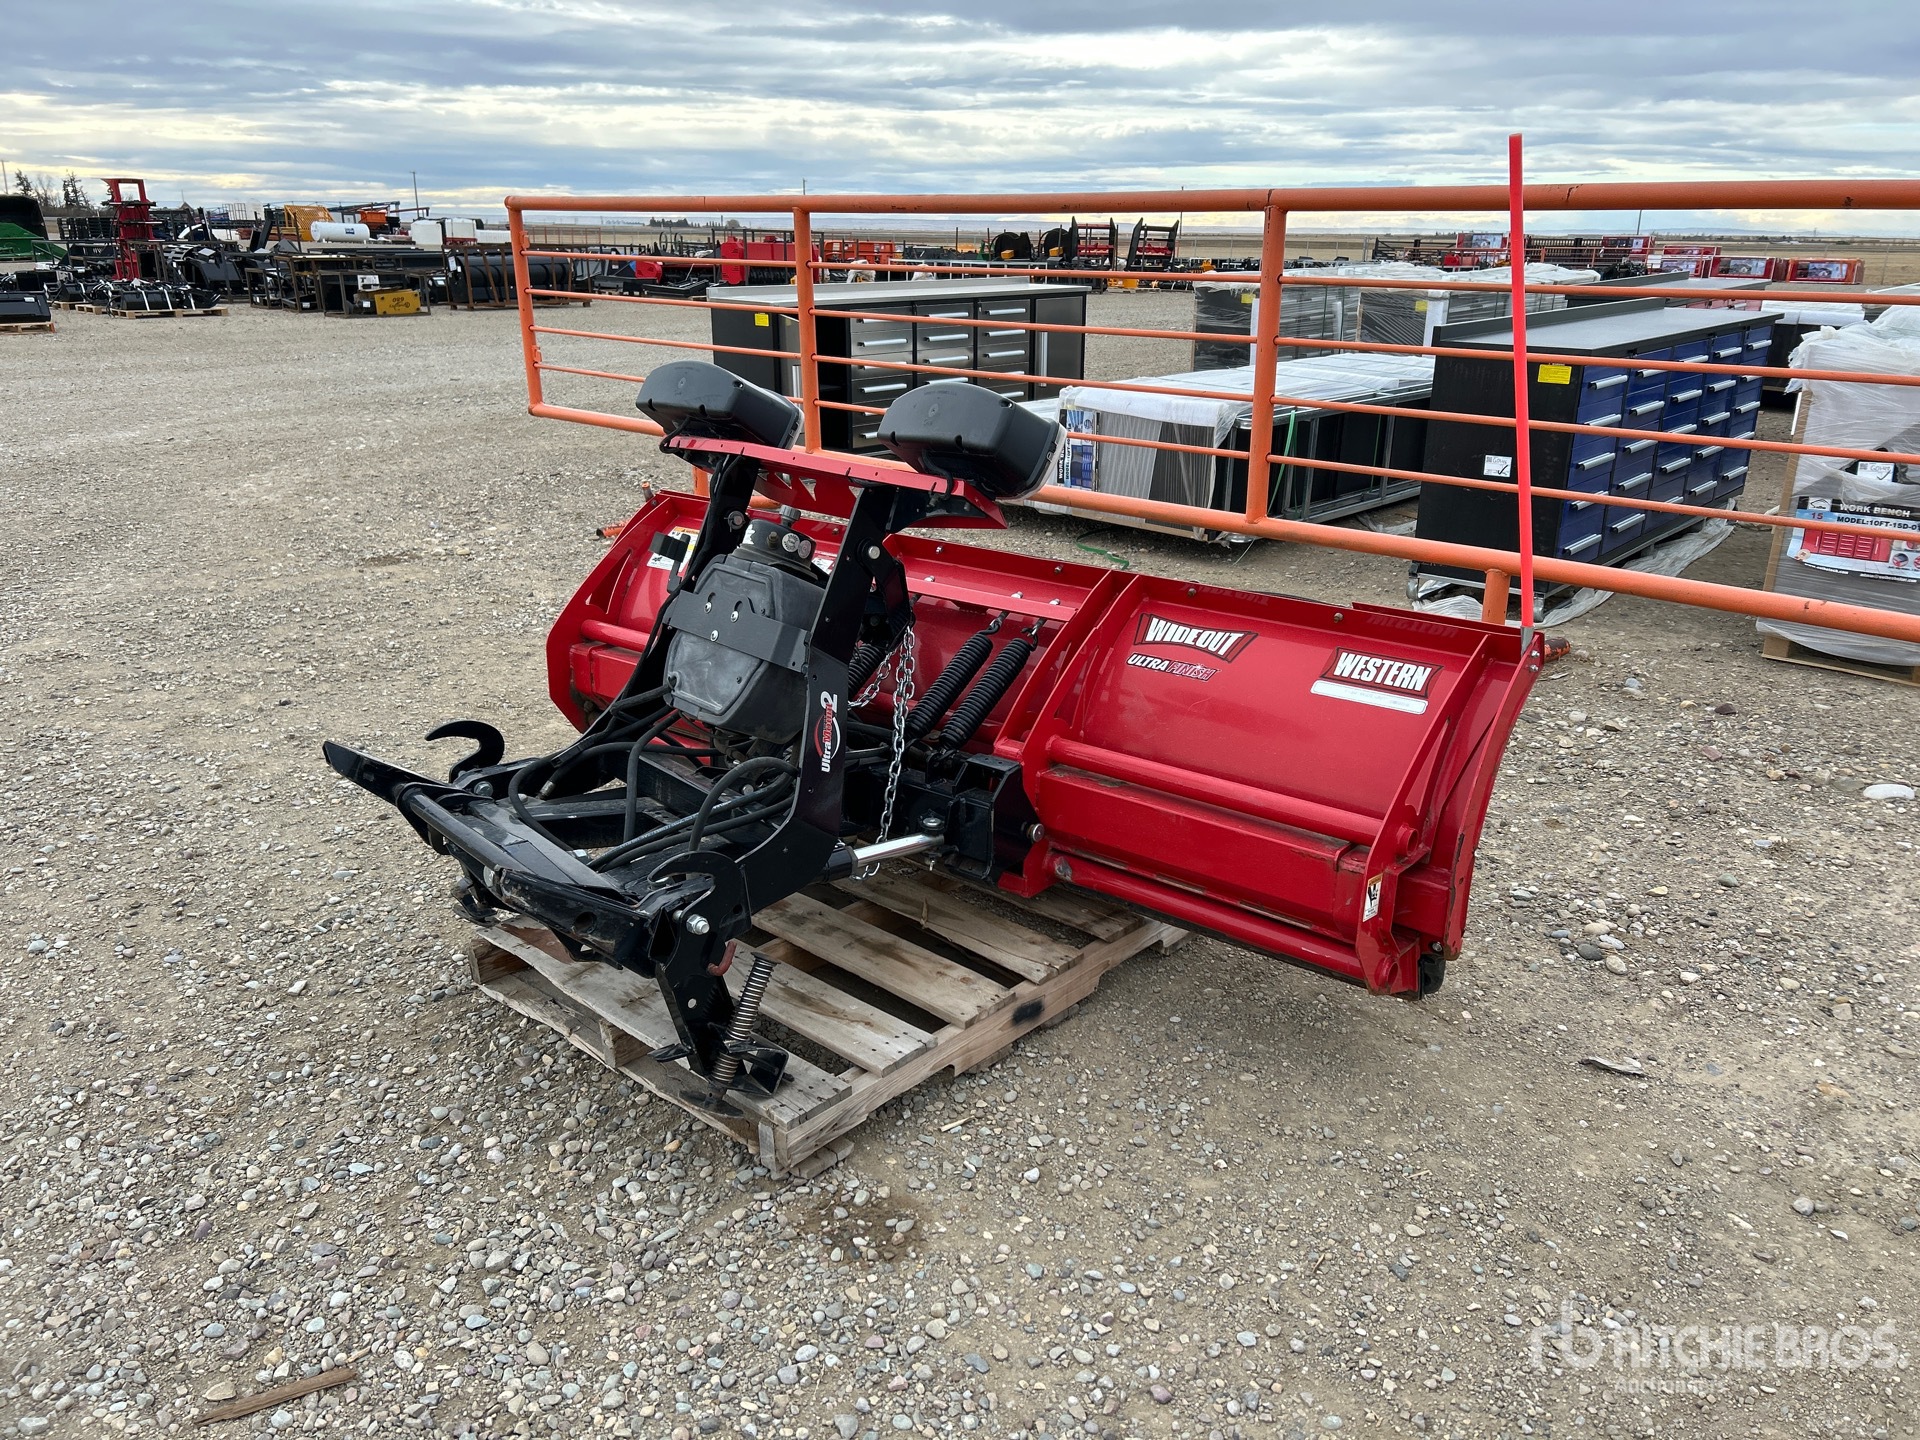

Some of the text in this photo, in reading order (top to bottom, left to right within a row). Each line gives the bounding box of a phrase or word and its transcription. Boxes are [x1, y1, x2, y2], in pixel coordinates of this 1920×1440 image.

[1811, 512, 1824, 520] 15
[1839, 503, 1911, 518] WORK BENCH
[1144, 617, 1244, 656] WIDEOUT
[1127, 653, 1217, 681] ULTRA FINISH
[1333, 652, 1433, 692] WESTERN
